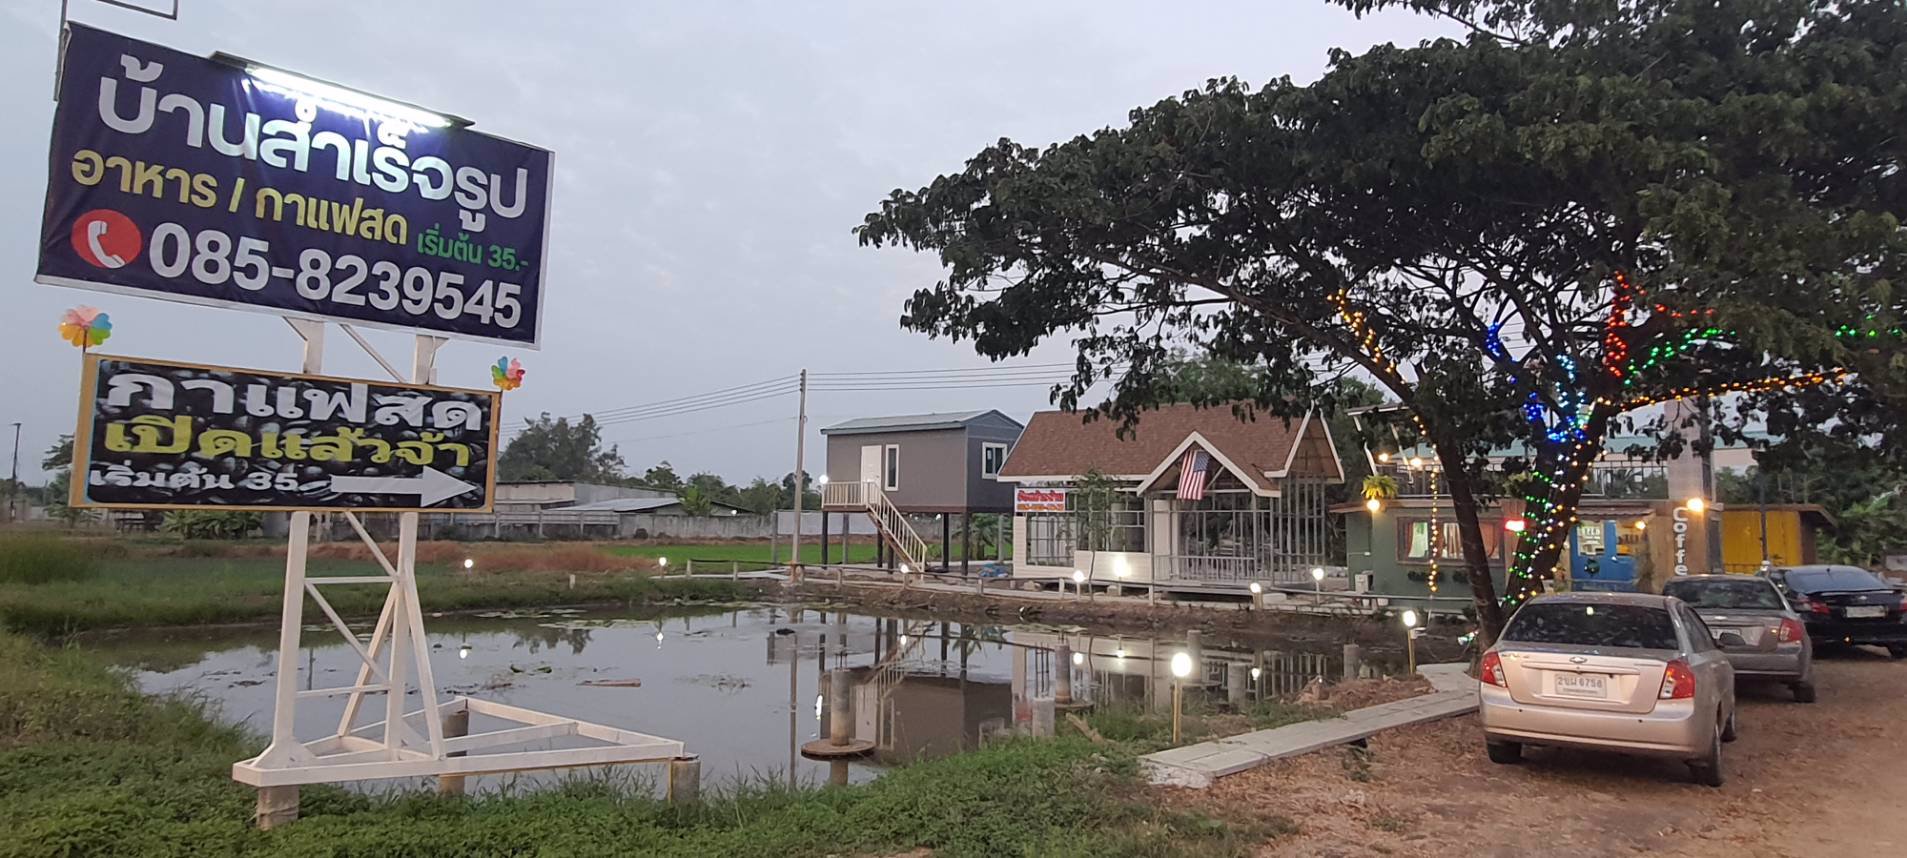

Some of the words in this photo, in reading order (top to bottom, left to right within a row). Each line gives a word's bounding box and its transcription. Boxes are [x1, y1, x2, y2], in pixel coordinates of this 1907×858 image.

[97, 53, 529, 233] บ้านสำเร็จรูป
[71, 146, 218, 208] อาหาร
[228, 176, 246, 214] /
[254, 185, 409, 246] กาแฟสด
[417, 222, 483, 265] เริ่มต้น
[148, 221, 523, 329] 085-8239545
[103, 414, 471, 468] เปิดแล้วจ้า
[106, 371, 482, 432] กาแฟสด
